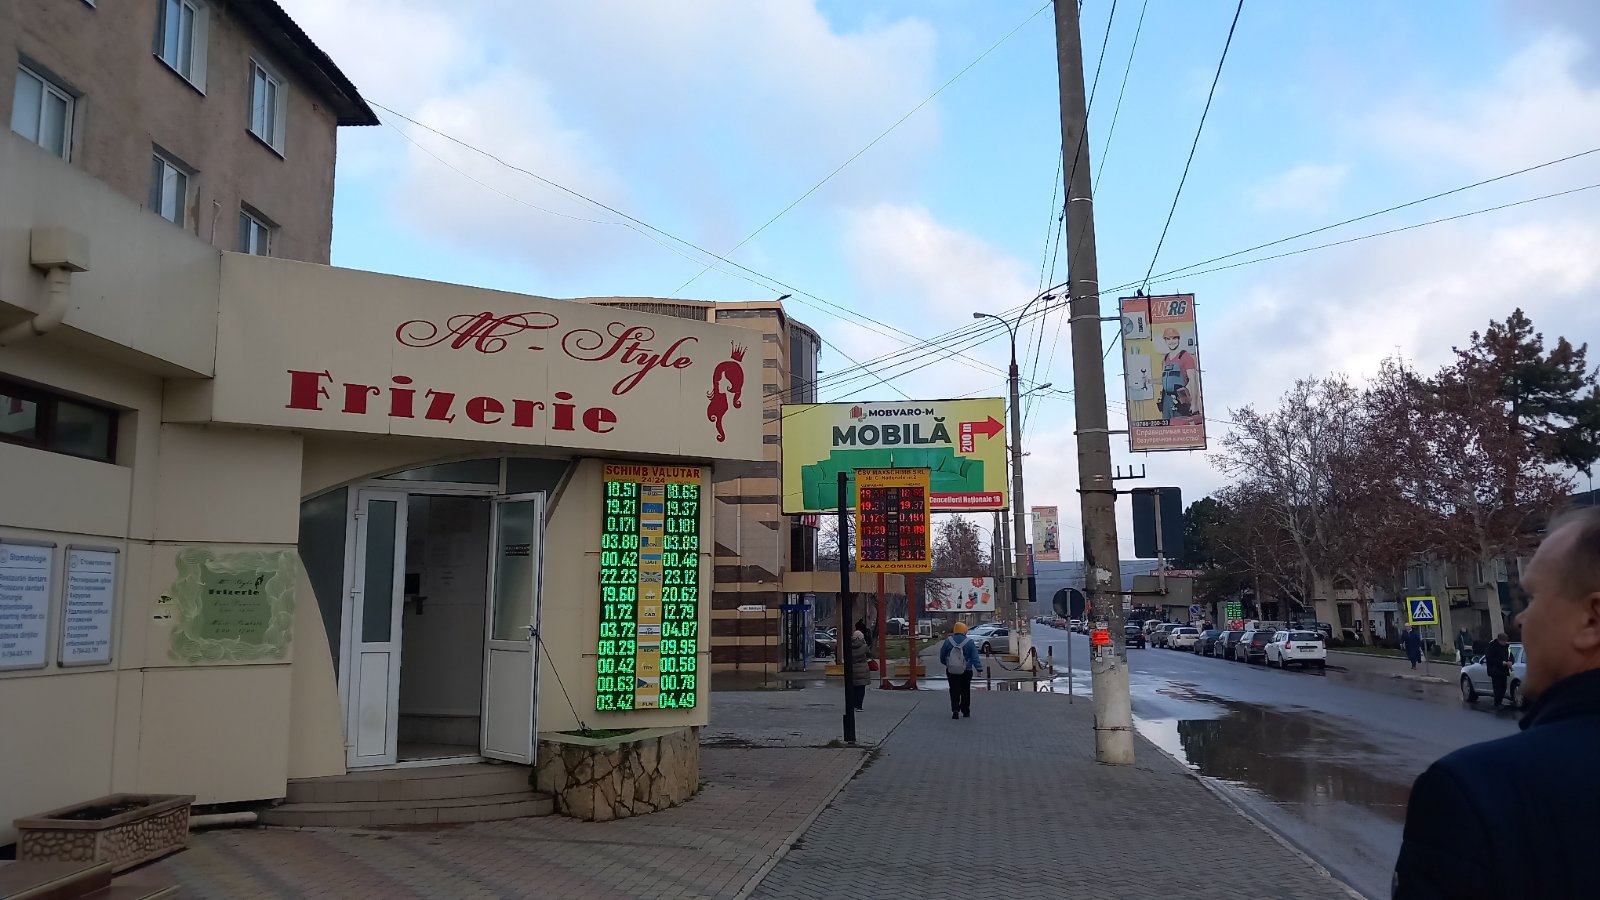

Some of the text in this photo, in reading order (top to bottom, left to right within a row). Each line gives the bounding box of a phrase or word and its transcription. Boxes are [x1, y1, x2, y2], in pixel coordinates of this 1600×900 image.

[562, 322, 698, 396] Style
[284, 369, 618, 435] Frizerie
[868, 408, 934, 416] MOBVARO-M
[832, 416, 952, 446] MOBILĂ
[962, 424, 972, 452] 200 m
[606, 466, 700, 478] SCHIMB VALUTAR
[607, 482, 636, 497] 18.51
[667, 485, 698, 499] 18.65
[607, 499, 636, 514] 19.21
[666, 501, 697, 516] 19.37
[607, 516, 636, 532] 0.171
[667, 518, 695, 533] 0.181
[602, 534, 638, 549] 03.80
[663, 536, 698, 551] 03.89
[601, 551, 638, 567] 00.42
[663, 552, 698, 568] 00.46
[601, 569, 637, 584] 22.23
[664, 570, 696, 584] 23.12
[603, 587, 635, 602] 19.60
[662, 587, 697, 602] 20.62
[605, 604, 632, 619] 11.72
[664, 604, 694, 620] 12.79
[600, 622, 636, 637] 03.72
[662, 622, 697, 637] 04.87
[598, 640, 635, 655] 08.29
[660, 640, 696, 655] 09.95
[598, 658, 635, 673] 00.42
[597, 676, 634, 692] 00.63
[661, 675, 695, 690] 00.78
[596, 694, 633, 710] 03.42
[659, 693, 695, 708] 04.49
